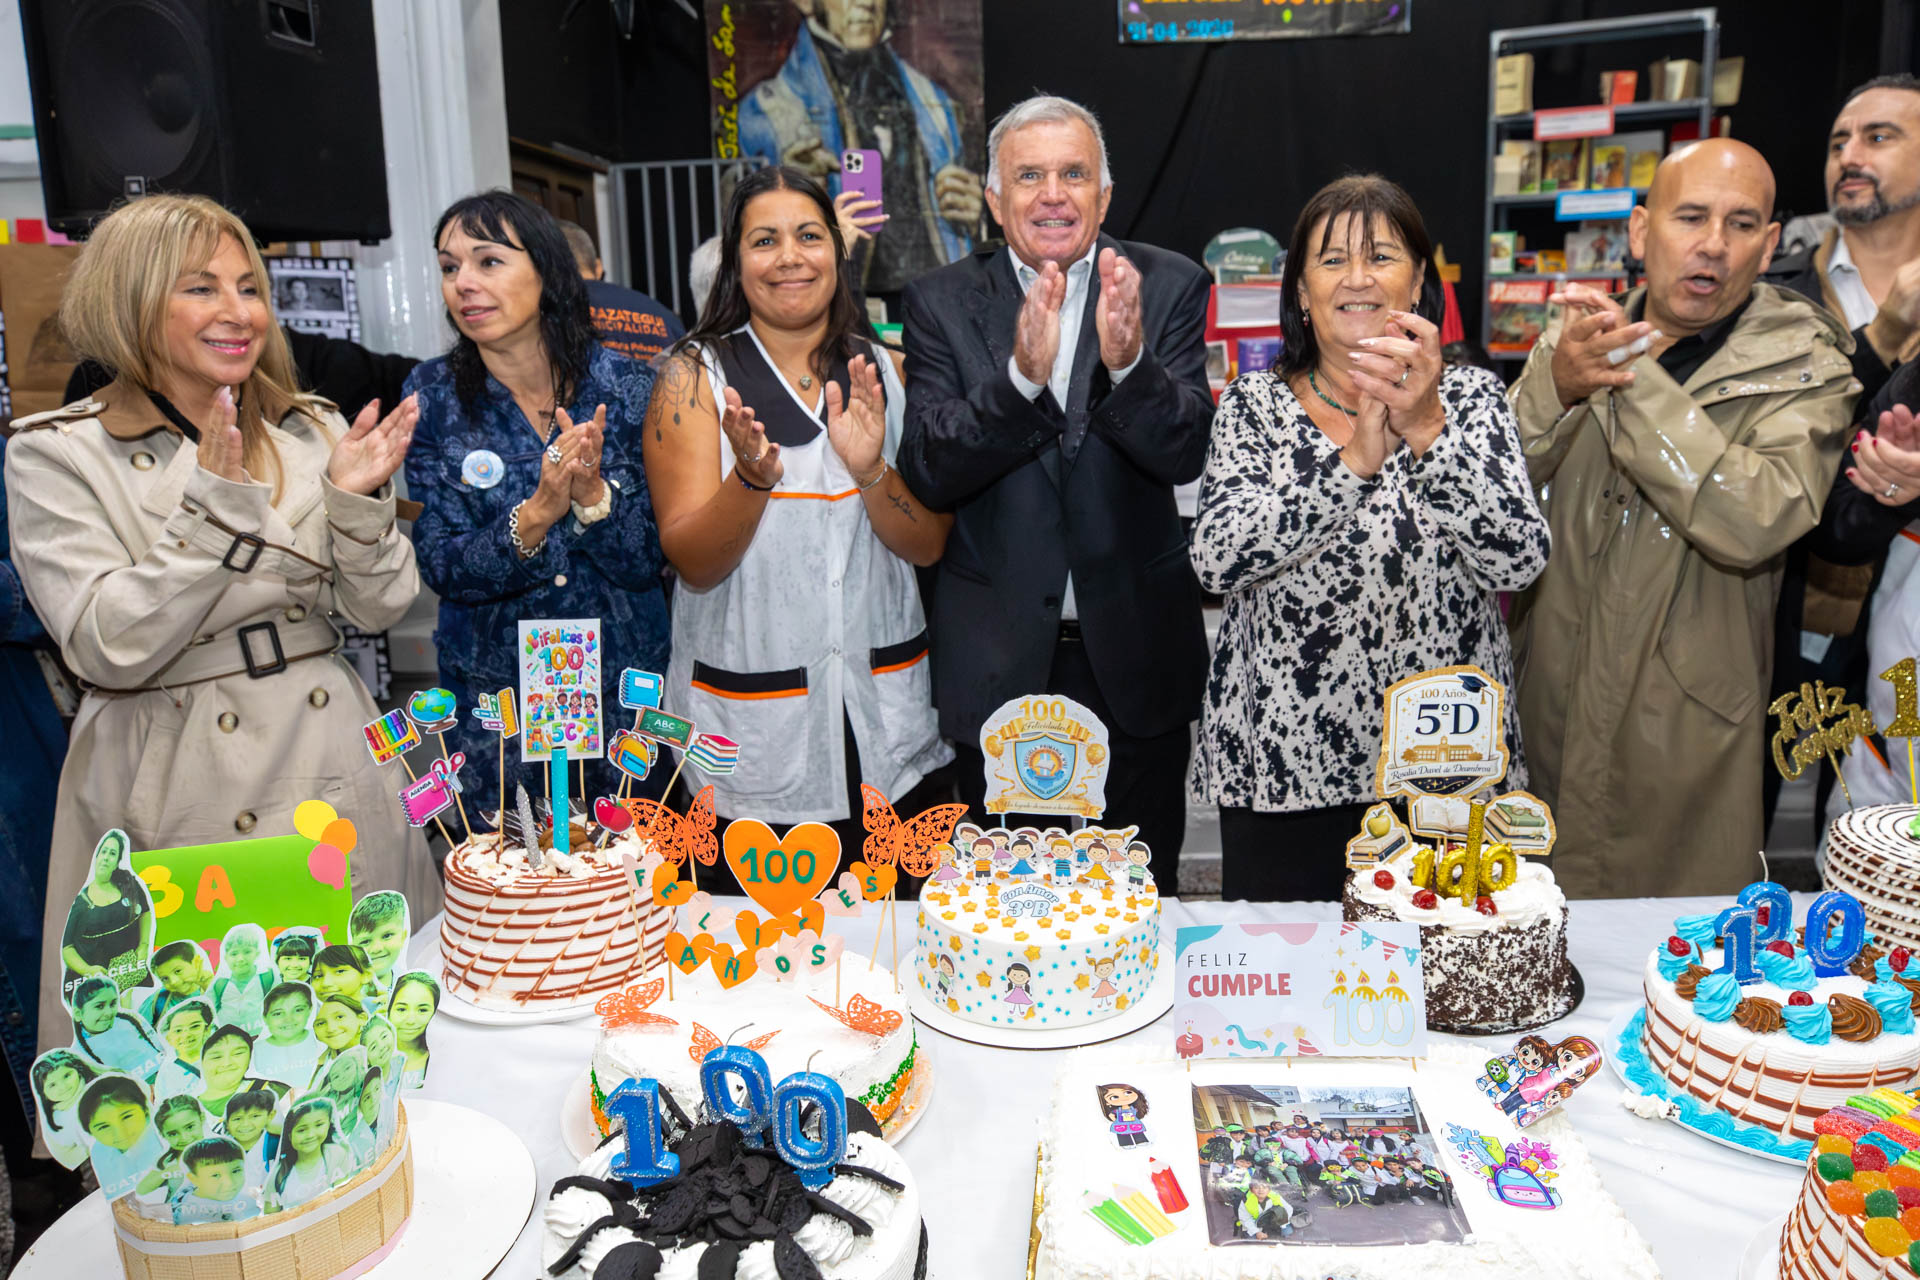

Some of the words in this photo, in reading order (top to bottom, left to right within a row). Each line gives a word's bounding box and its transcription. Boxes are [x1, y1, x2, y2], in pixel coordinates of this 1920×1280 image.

[537, 645, 585, 673] 100
[544, 670, 584, 686] años!
[1420, 688, 1440, 699] 100
[1441, 688, 1468, 699] Años
[1018, 699, 1067, 722] 100
[653, 718, 676, 730] ABC
[409, 780, 433, 798] AGENDA
[739, 847, 817, 885] 100
[1000, 886, 1024, 905] Con
[1024, 883, 1061, 903] Amor
[678, 944, 827, 982] AÑOS
[1187, 952, 1248, 969] FELIZ
[1187, 972, 1292, 998] CUMPLE
[1322, 984, 1416, 1047] 100
[603, 1044, 848, 1193] 100
